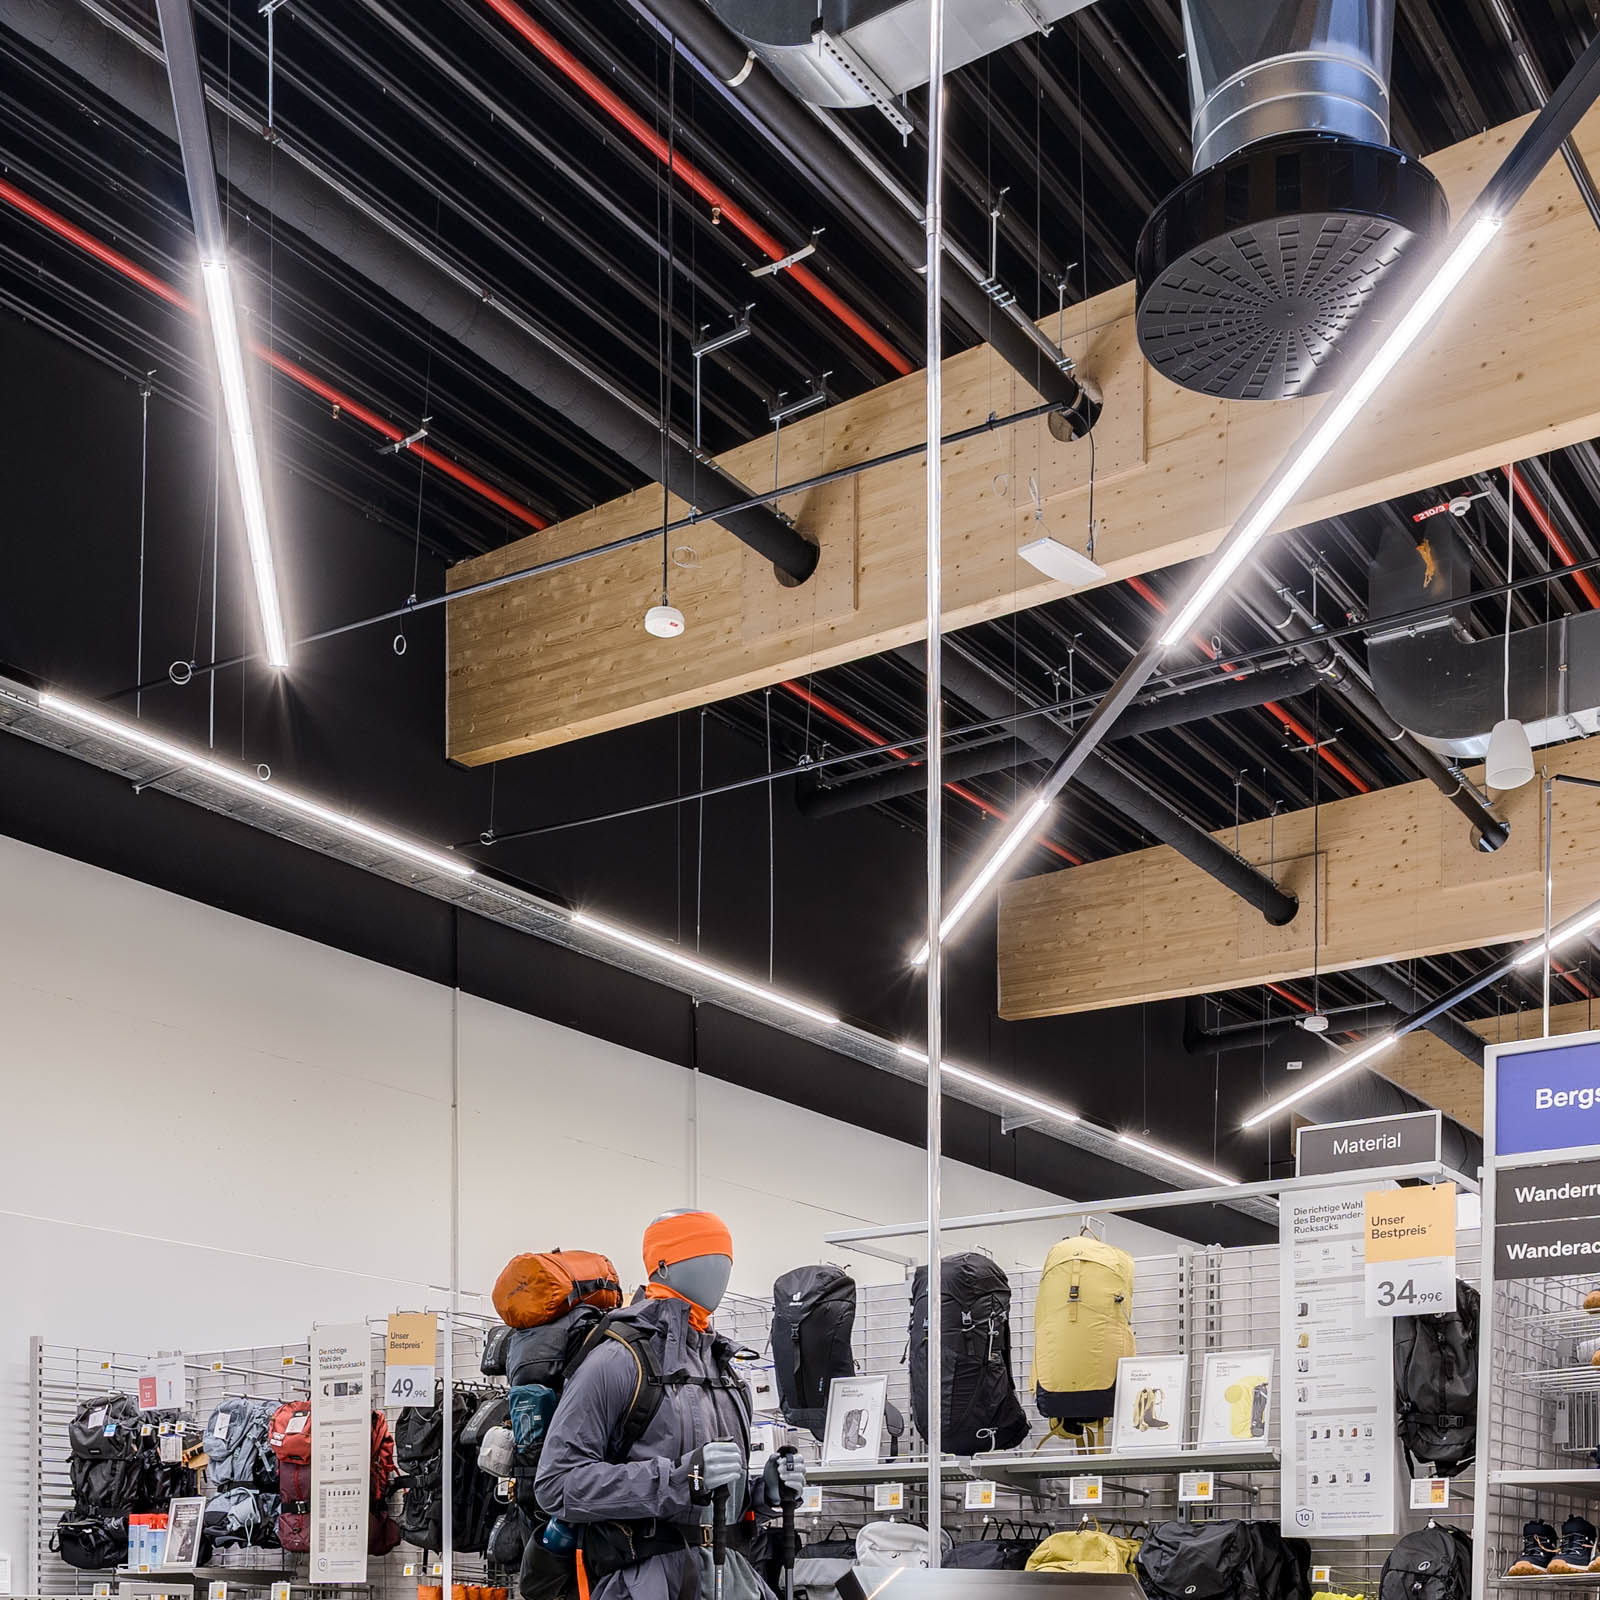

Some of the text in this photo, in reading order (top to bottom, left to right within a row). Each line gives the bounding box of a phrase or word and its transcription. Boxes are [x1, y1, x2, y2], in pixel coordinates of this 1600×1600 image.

[1333, 1132, 1401, 1155] Material
[1294, 1200, 1363, 1216] Die richtige Wahl
[1294, 1211, 1364, 1225] des Bergwander-
[1371, 1216, 1405, 1227] Unser
[1294, 1223, 1338, 1234] Rucksacks
[1371, 1225, 1426, 1241] Bestpreis
[390, 1332, 409, 1340] Unser
[390, 1341, 420, 1351] Bestpreis
[319, 1355, 332, 1363] Wahl
[1300, 1513, 1310, 1521] 10
